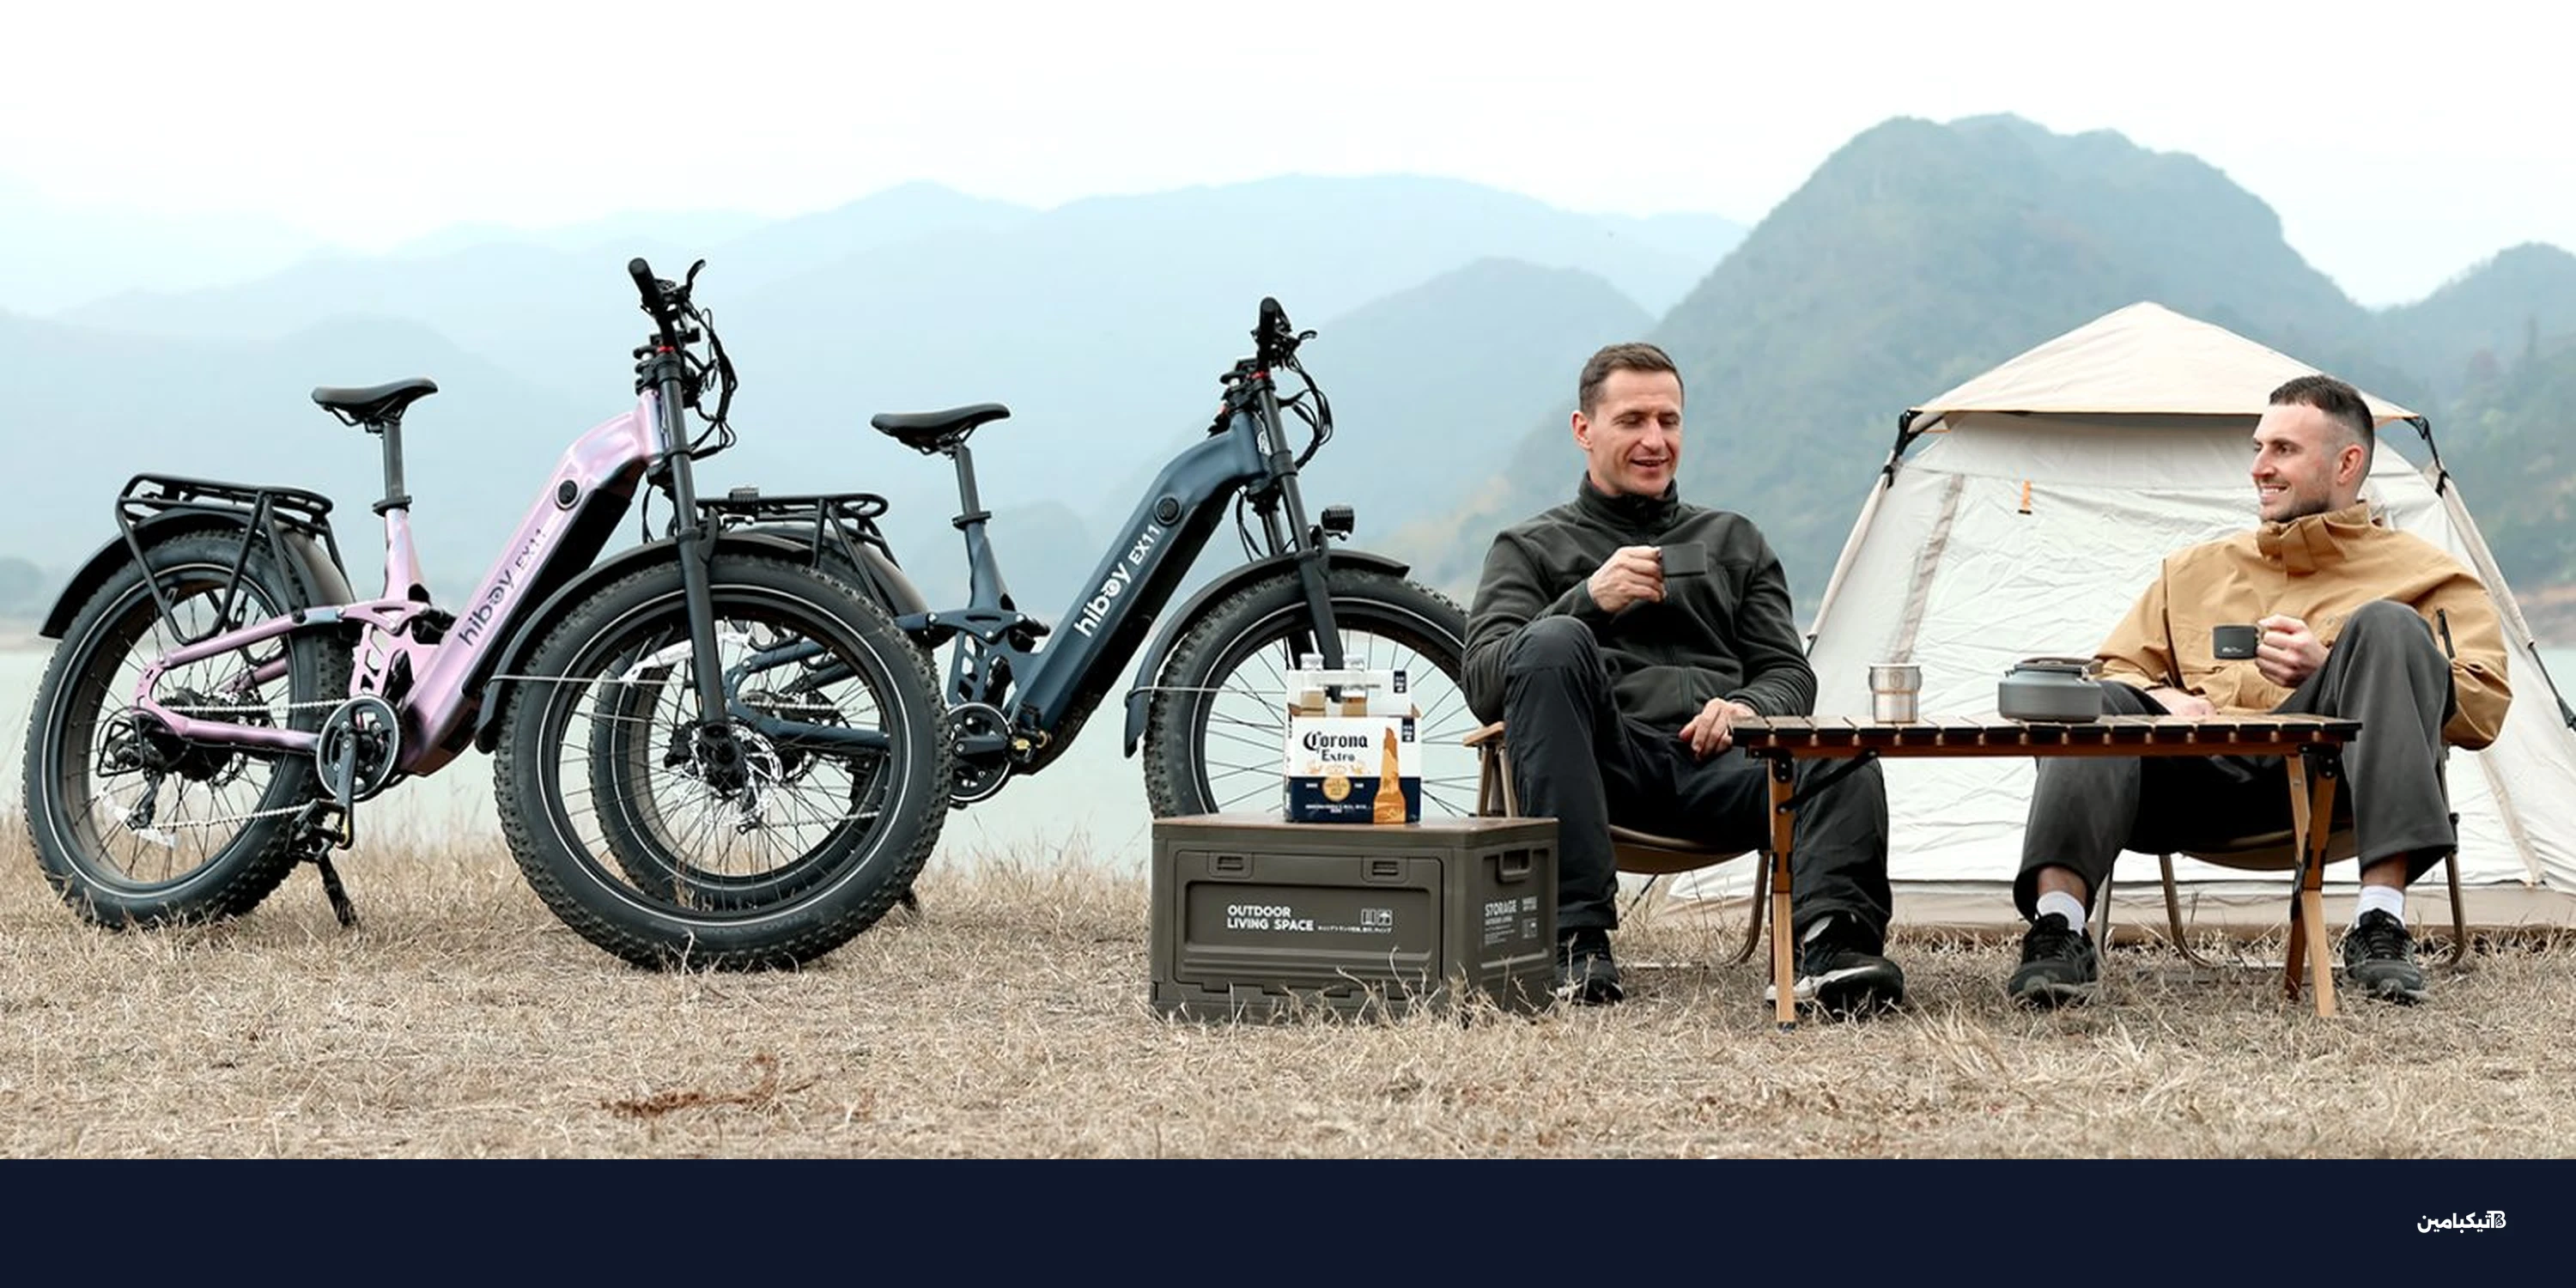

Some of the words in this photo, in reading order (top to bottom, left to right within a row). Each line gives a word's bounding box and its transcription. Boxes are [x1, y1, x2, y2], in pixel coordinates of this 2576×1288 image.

[458, 568, 514, 647] hiboy
[515, 527, 547, 571] EX11
[1073, 562, 1132, 637] hiboy
[1127, 524, 1160, 566] EX11
[1303, 730, 1369, 753] Corona
[1227, 905, 1291, 918] OUTDOOR
[1485, 900, 1517, 917] STORAGE
[1227, 918, 1269, 929] LIVING
[1273, 919, 1315, 932] SPACE
